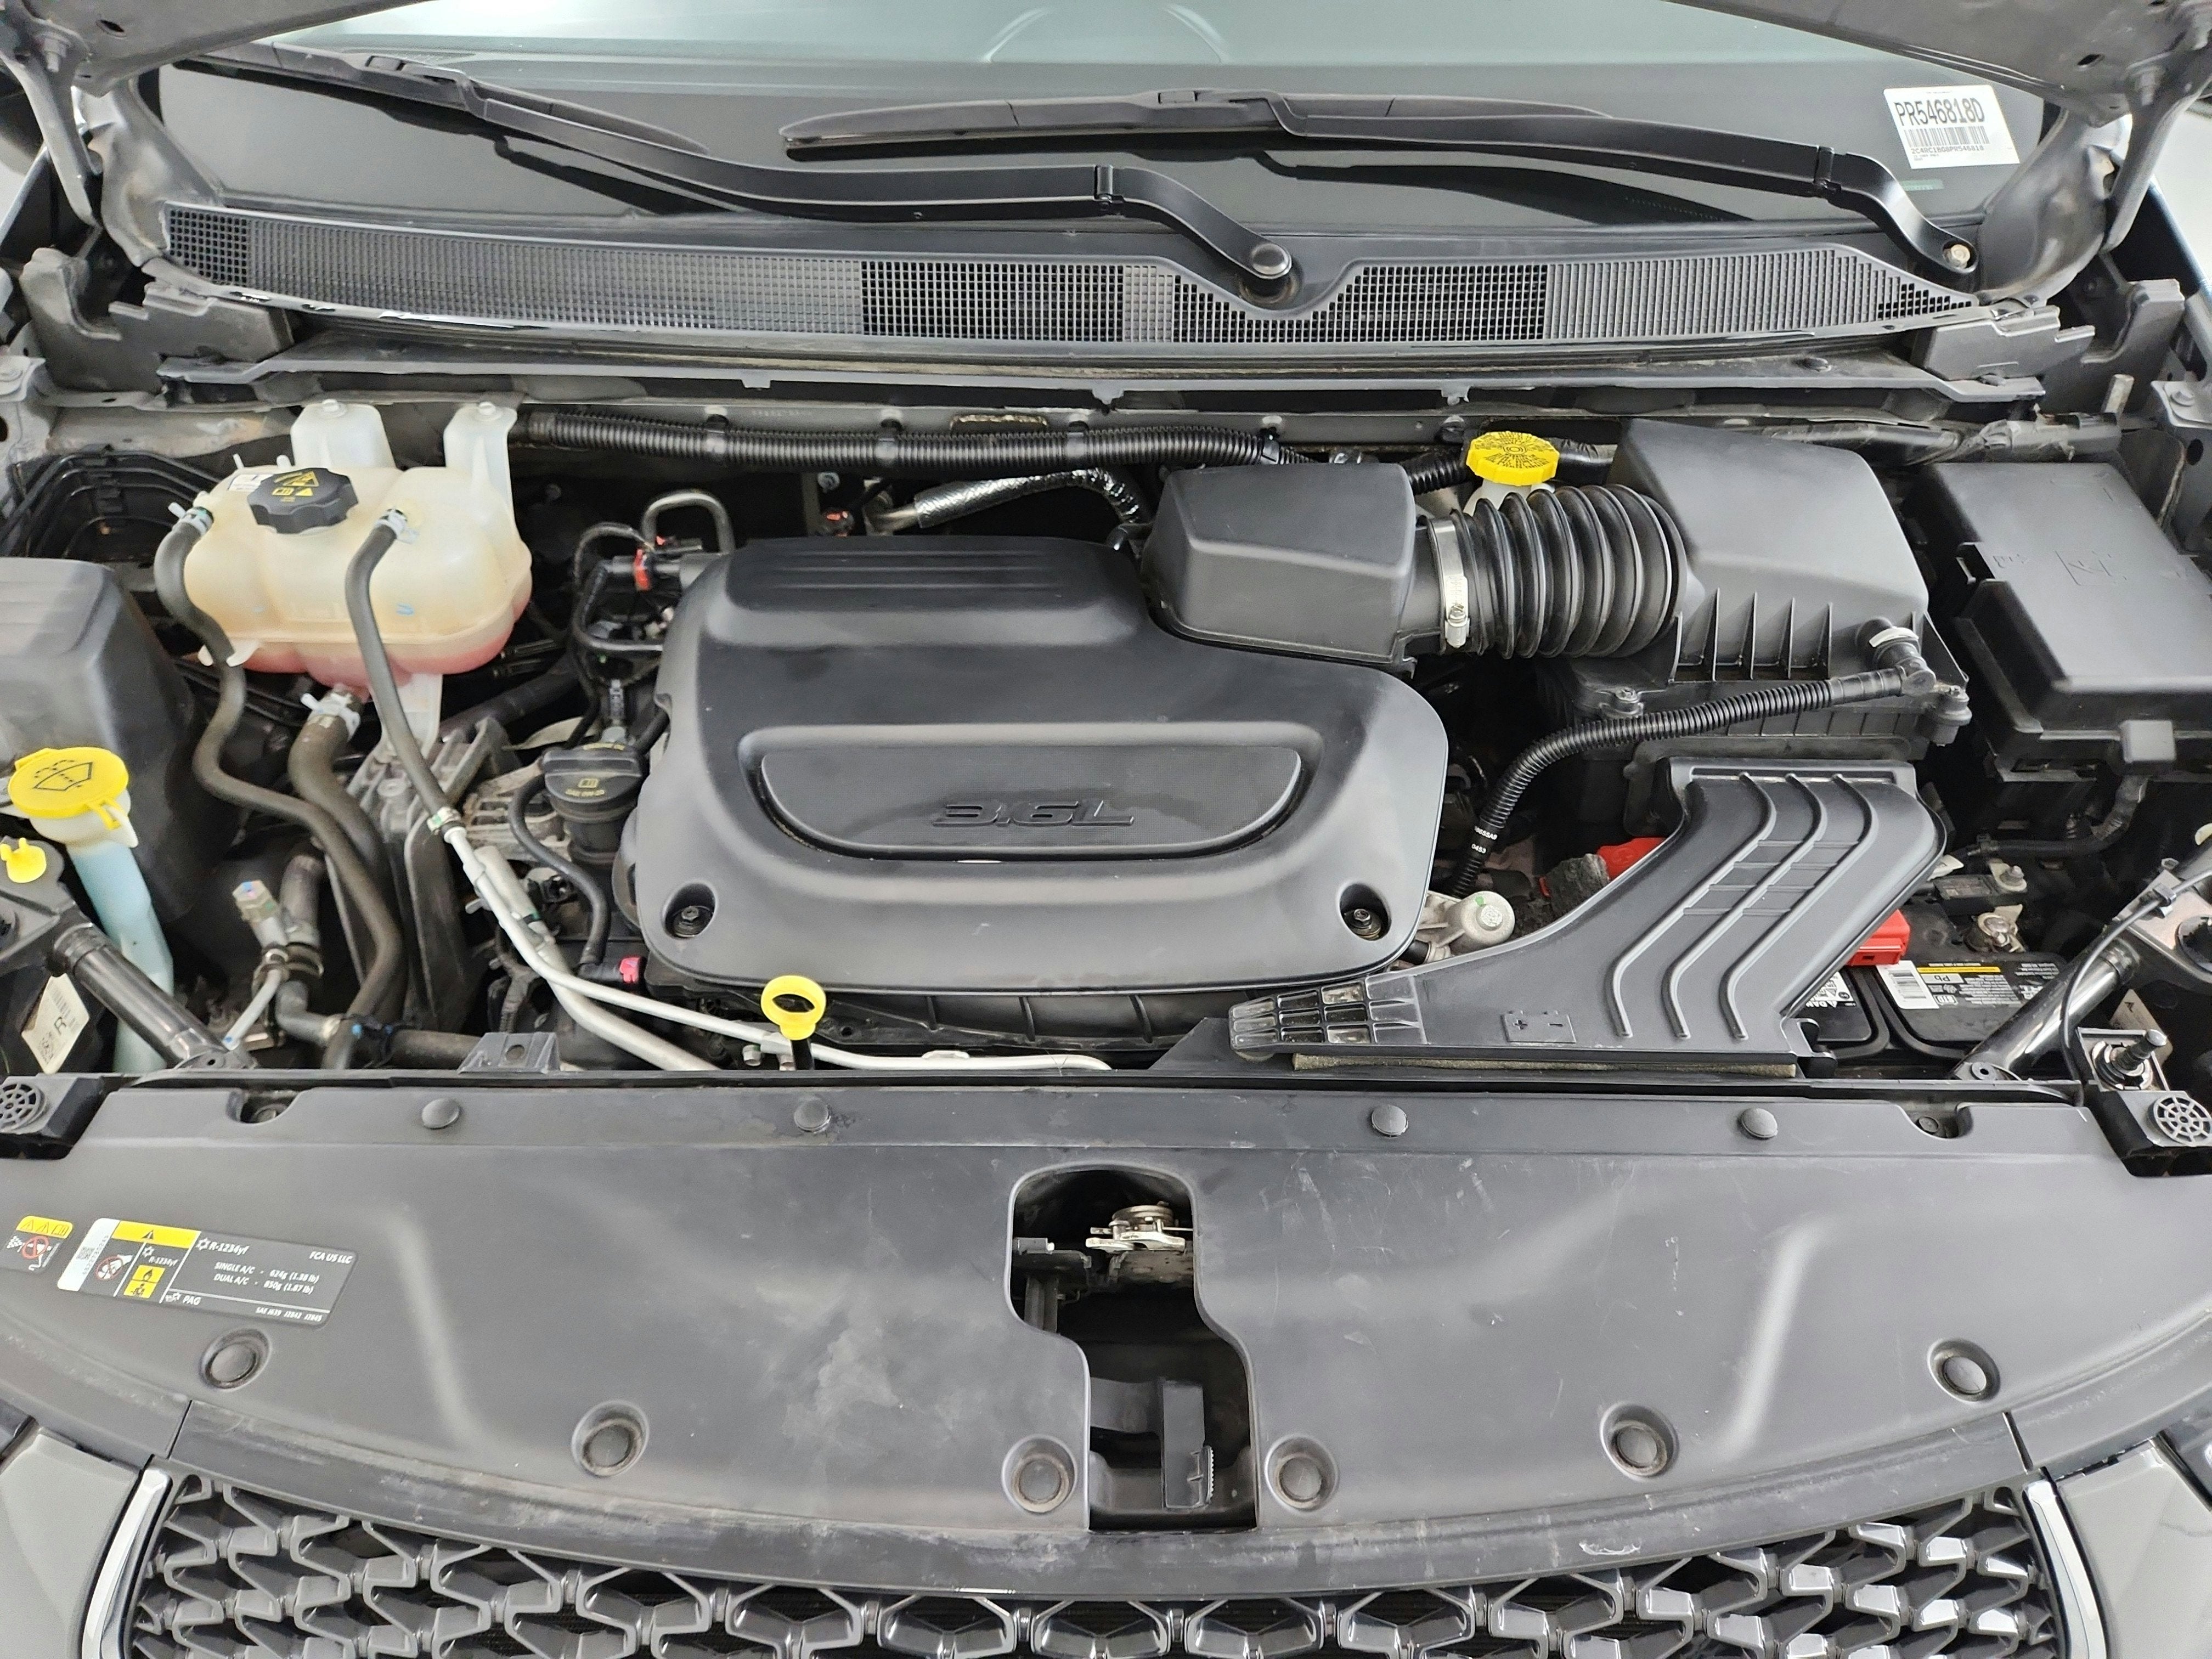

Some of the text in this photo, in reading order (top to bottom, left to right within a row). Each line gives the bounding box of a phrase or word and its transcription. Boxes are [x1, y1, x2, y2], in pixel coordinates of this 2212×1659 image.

[1893, 97, 1985, 126] PR546818D
[933, 799, 1134, 827] 3.6L
[208, 1241, 250, 1256] R-1234yf
[309, 1251, 353, 1264] FCA US LLC
[214, 1262, 241, 1272] SINGLE
[239, 1265, 256, 1274] A/C
[234, 1276, 250, 1285] A/C
[183, 1295, 202, 1306] PAG
[255, 1306, 268, 1314] SAE
